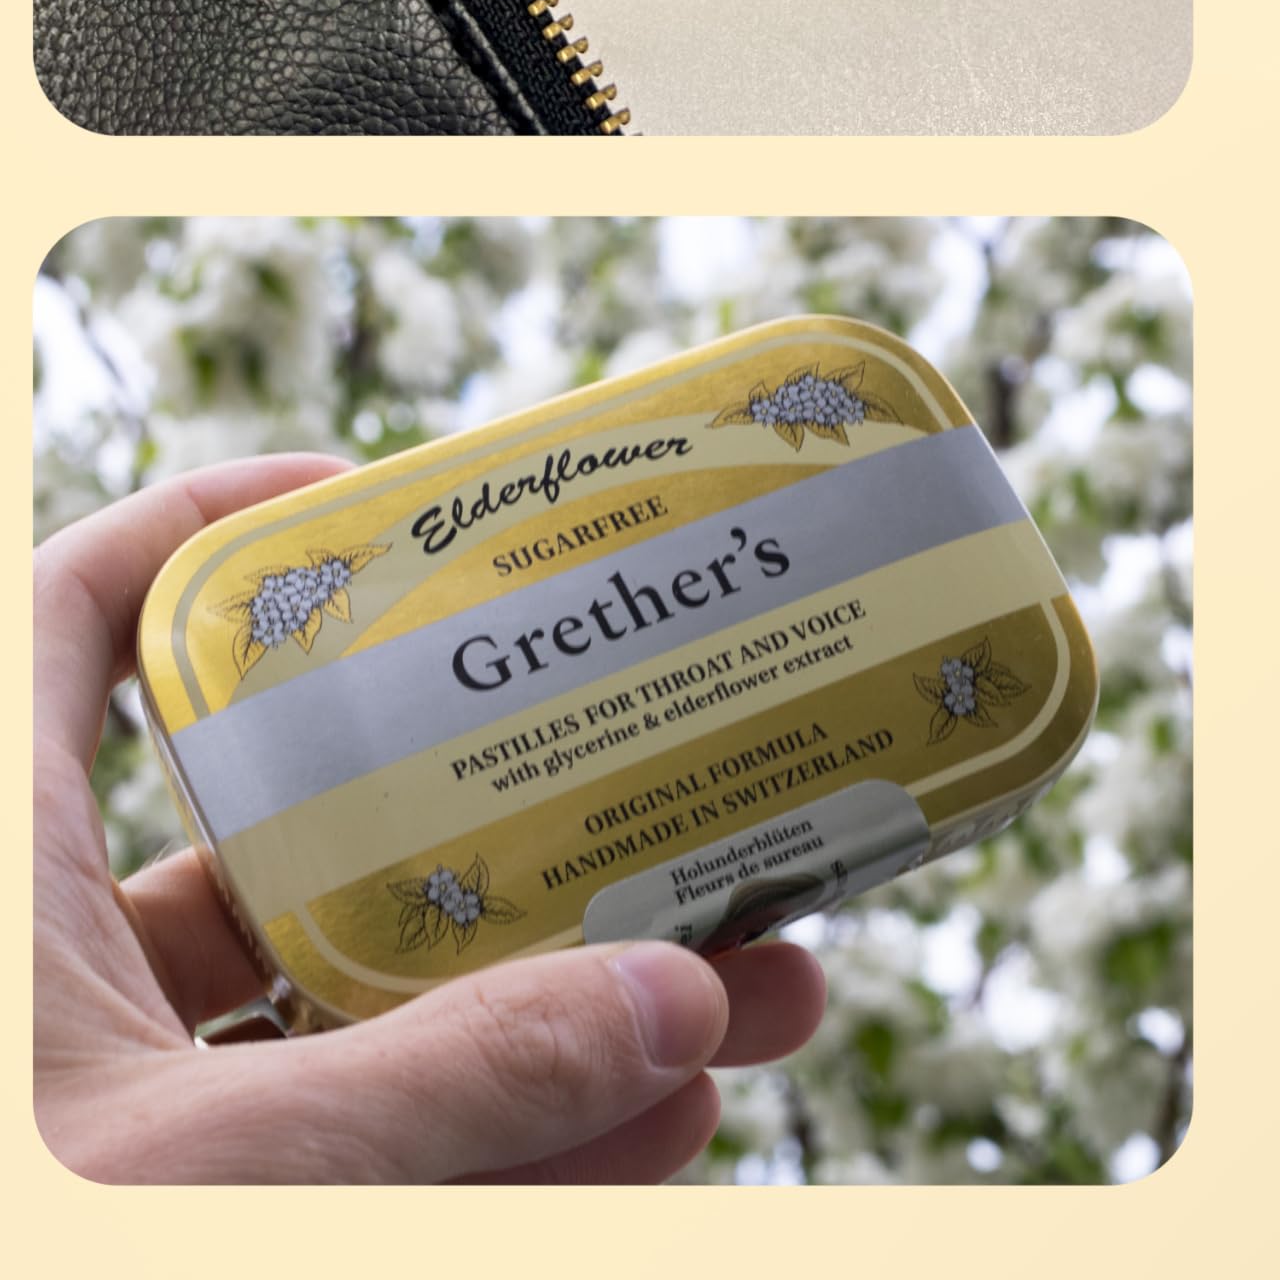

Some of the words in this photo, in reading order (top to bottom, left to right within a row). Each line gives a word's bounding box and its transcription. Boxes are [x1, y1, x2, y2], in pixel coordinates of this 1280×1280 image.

[411, 434, 693, 555] Elderflower
[492, 495, 668, 577] SUGARFREE
[450, 714, 580, 781] PASTILLES
[584, 693, 632, 727] FOR
[636, 652, 735, 711] THROAT
[739, 630, 791, 666] AND
[791, 598, 867, 638] VOICE
[491, 762, 540, 794] with
[540, 722, 640, 778] glycerine
[644, 710, 662, 729] &
[662, 668, 781, 723] elderflower
[783, 634, 854, 674] extract
[540, 816, 690, 891] HANDMADE
[691, 801, 721, 828] IN
[722, 727, 894, 816] SWITZERLAND
[584, 775, 707, 837] ORIGINAL
[708, 722, 829, 785] FORMULA
[670, 820, 813, 887] Holunderblüten
[674, 874, 735, 906] Fleurs
[738, 860, 760, 878] de
[764, 835, 824, 869] sureau
